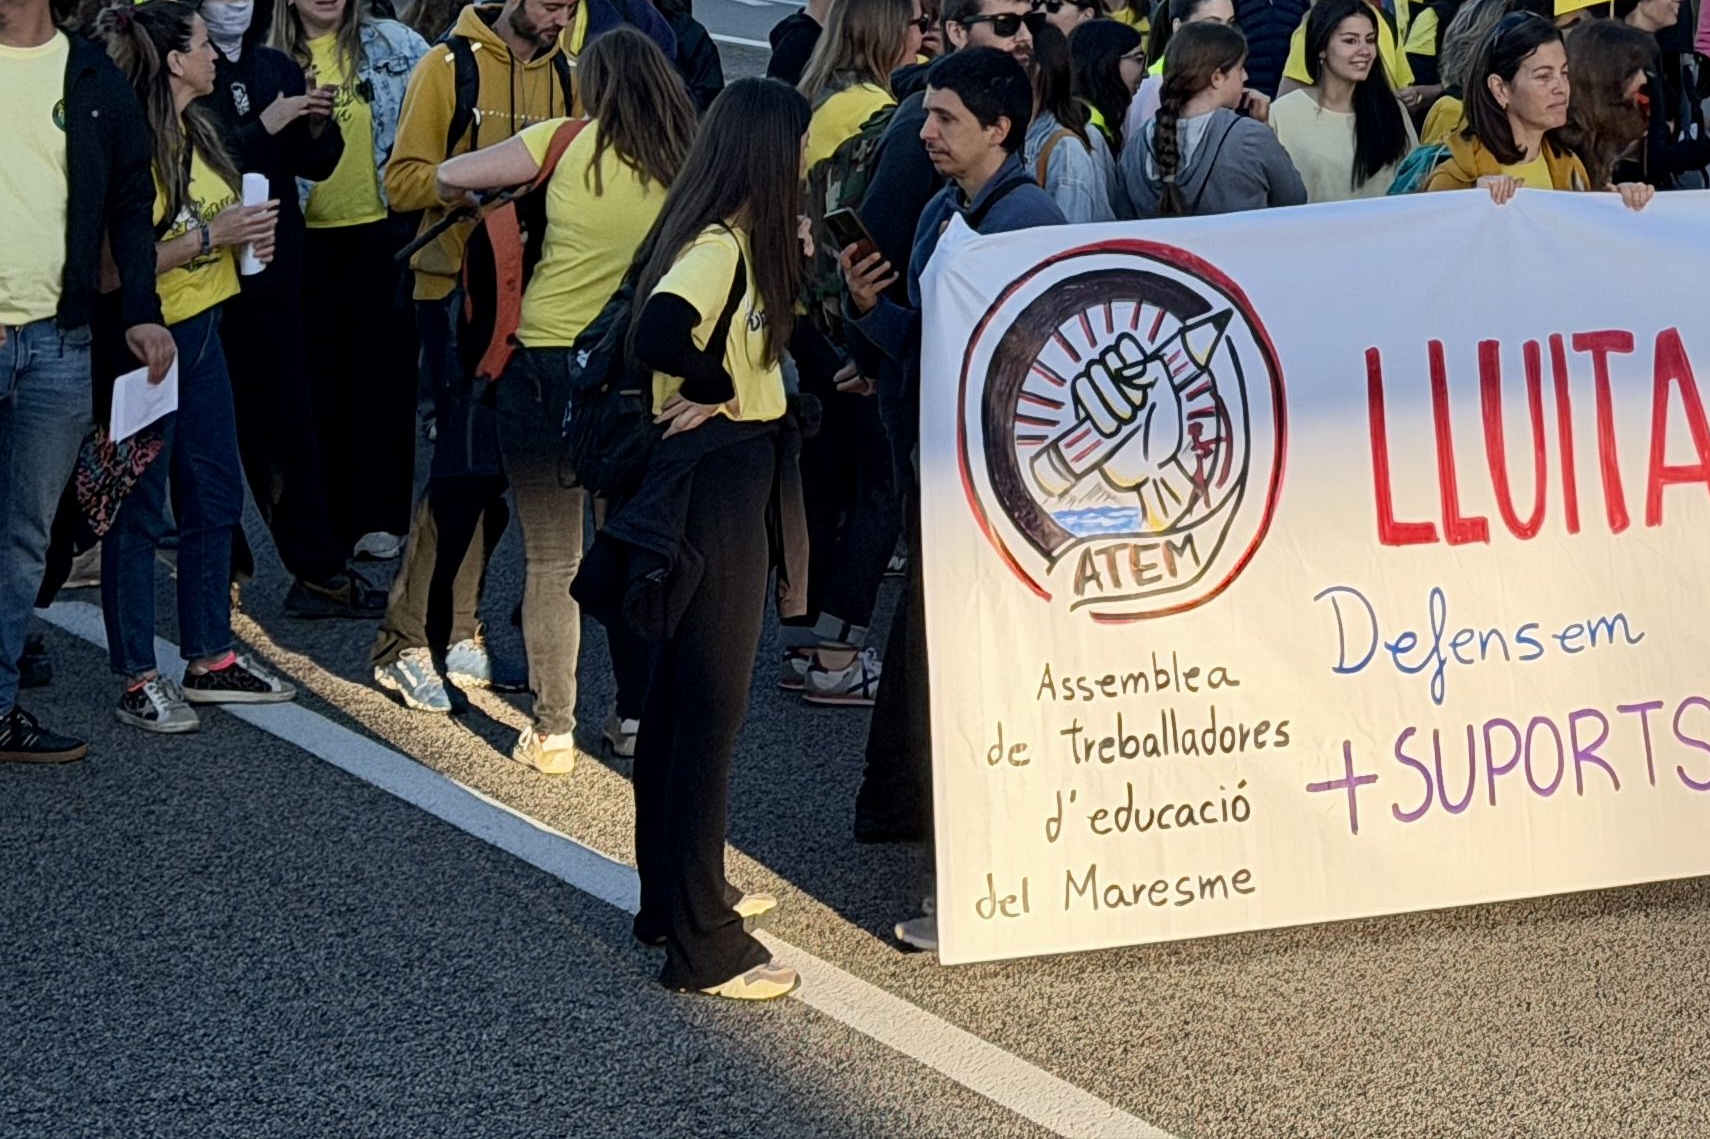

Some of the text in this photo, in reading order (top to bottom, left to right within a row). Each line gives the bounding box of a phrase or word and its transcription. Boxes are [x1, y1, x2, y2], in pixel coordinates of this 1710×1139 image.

[1073, 532, 1201, 596] ATEM
[1036, 650, 1241, 701] Assemblea
[1313, 586, 1646, 706] Defensem
[986, 705, 1291, 767] de treballadores
[1045, 779, 1251, 843] d'educació
[975, 863, 1257, 920] del Maresme
